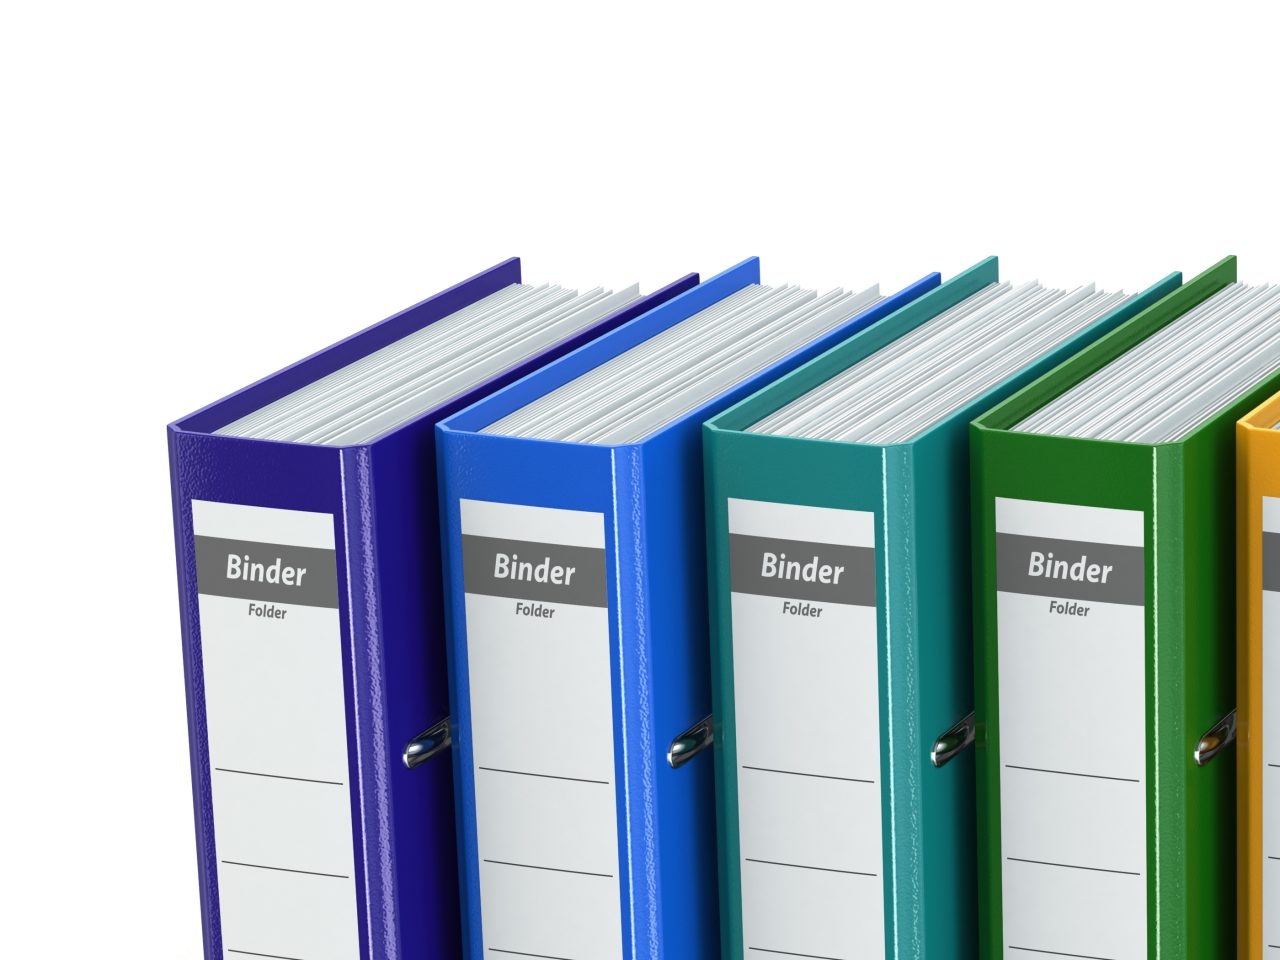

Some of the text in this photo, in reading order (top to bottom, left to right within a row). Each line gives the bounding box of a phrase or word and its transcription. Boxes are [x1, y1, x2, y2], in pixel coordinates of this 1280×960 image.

[227, 554, 306, 586] Binder
[494, 553, 575, 585] Binder
[762, 553, 844, 584] Binder
[1028, 552, 1113, 583] Binder
[249, 603, 287, 619] Folder
[516, 603, 555, 618] Folder
[783, 602, 822, 617] Folder
[1050, 601, 1090, 616] Folder
